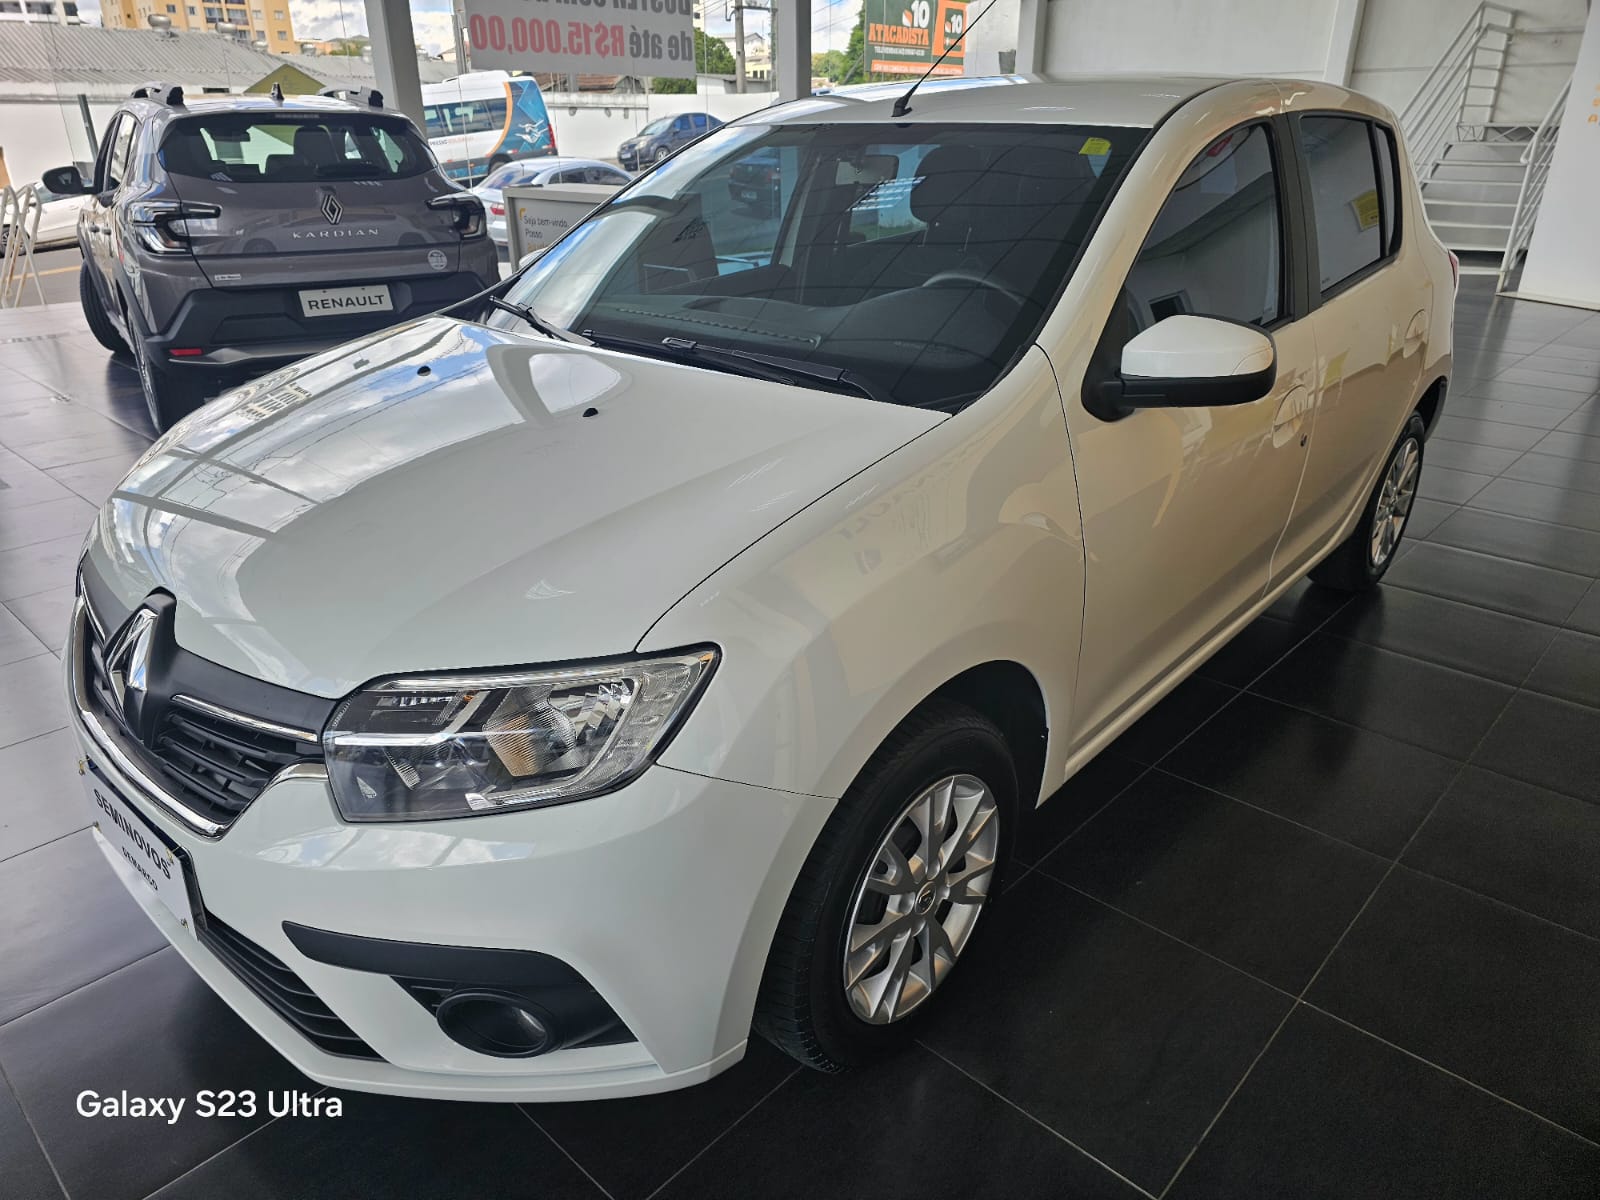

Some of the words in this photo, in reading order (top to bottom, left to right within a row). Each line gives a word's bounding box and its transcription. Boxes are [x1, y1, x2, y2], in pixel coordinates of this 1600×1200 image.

[910, 0, 930, 28] 10
[950, 14, 963, 34] 10
[868, 23, 929, 45] ATACADISTA
[292, 228, 379, 239] KARDIAN
[307, 294, 385, 311] RENAULT
[94, 788, 171, 880] SEMINOVOS
